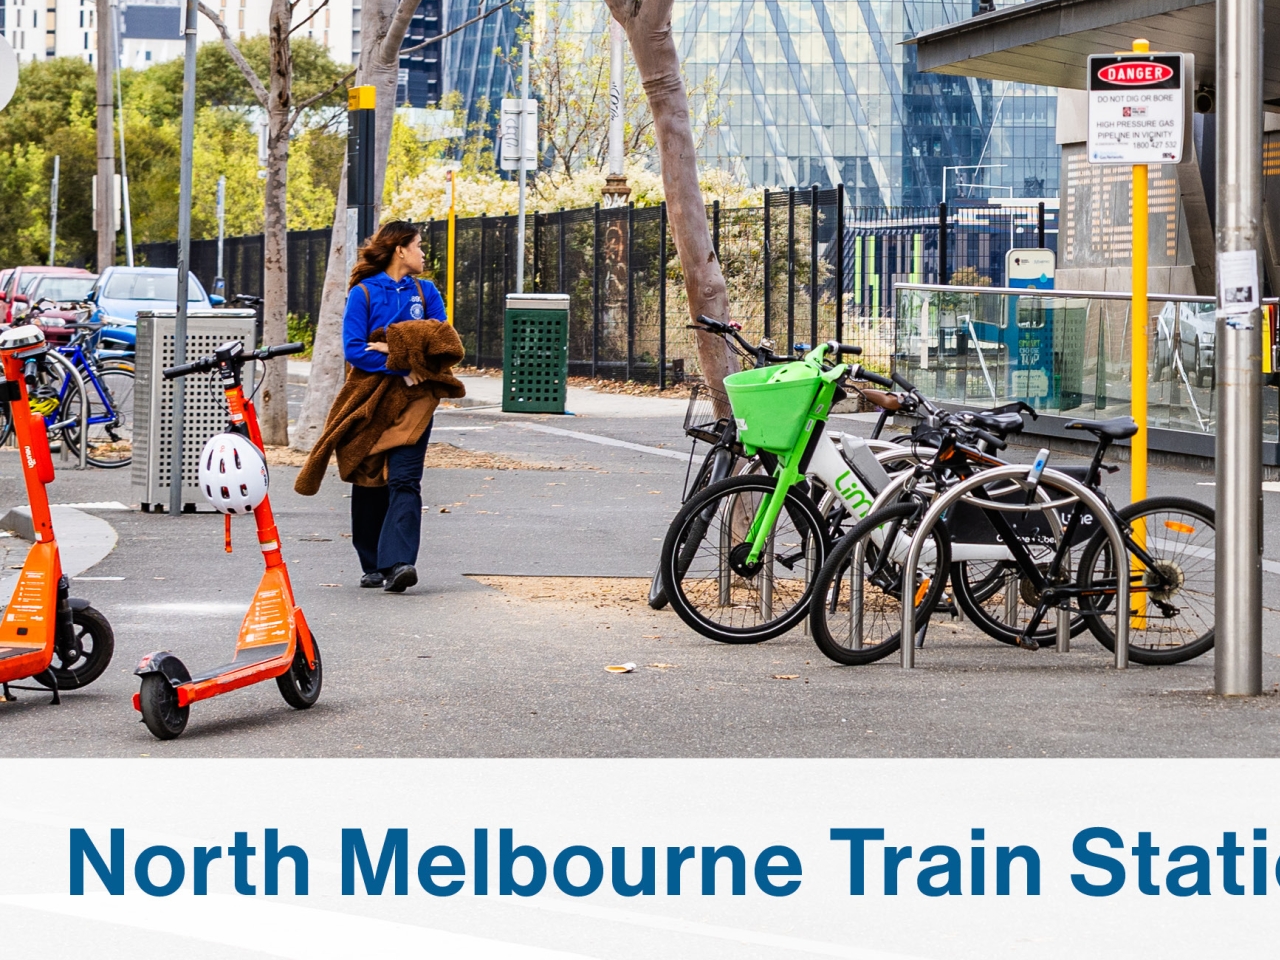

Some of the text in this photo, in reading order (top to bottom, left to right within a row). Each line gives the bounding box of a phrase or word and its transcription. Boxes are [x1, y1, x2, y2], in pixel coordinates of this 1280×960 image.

[1108, 67, 1163, 80] DANGER
[1097, 95, 1108, 103] DO
[1110, 95, 1125, 103] NOT
[1140, 94, 1151, 102] OR
[1096, 119, 1175, 128] HIGH PRESSURE GAS
[1097, 131, 1130, 139] PIPELINE
[1142, 130, 1173, 139] VICINITY
[1133, 141, 1150, 149] 1800
[1165, 140, 1177, 148] 532
[834, 470, 885, 529] Lim
